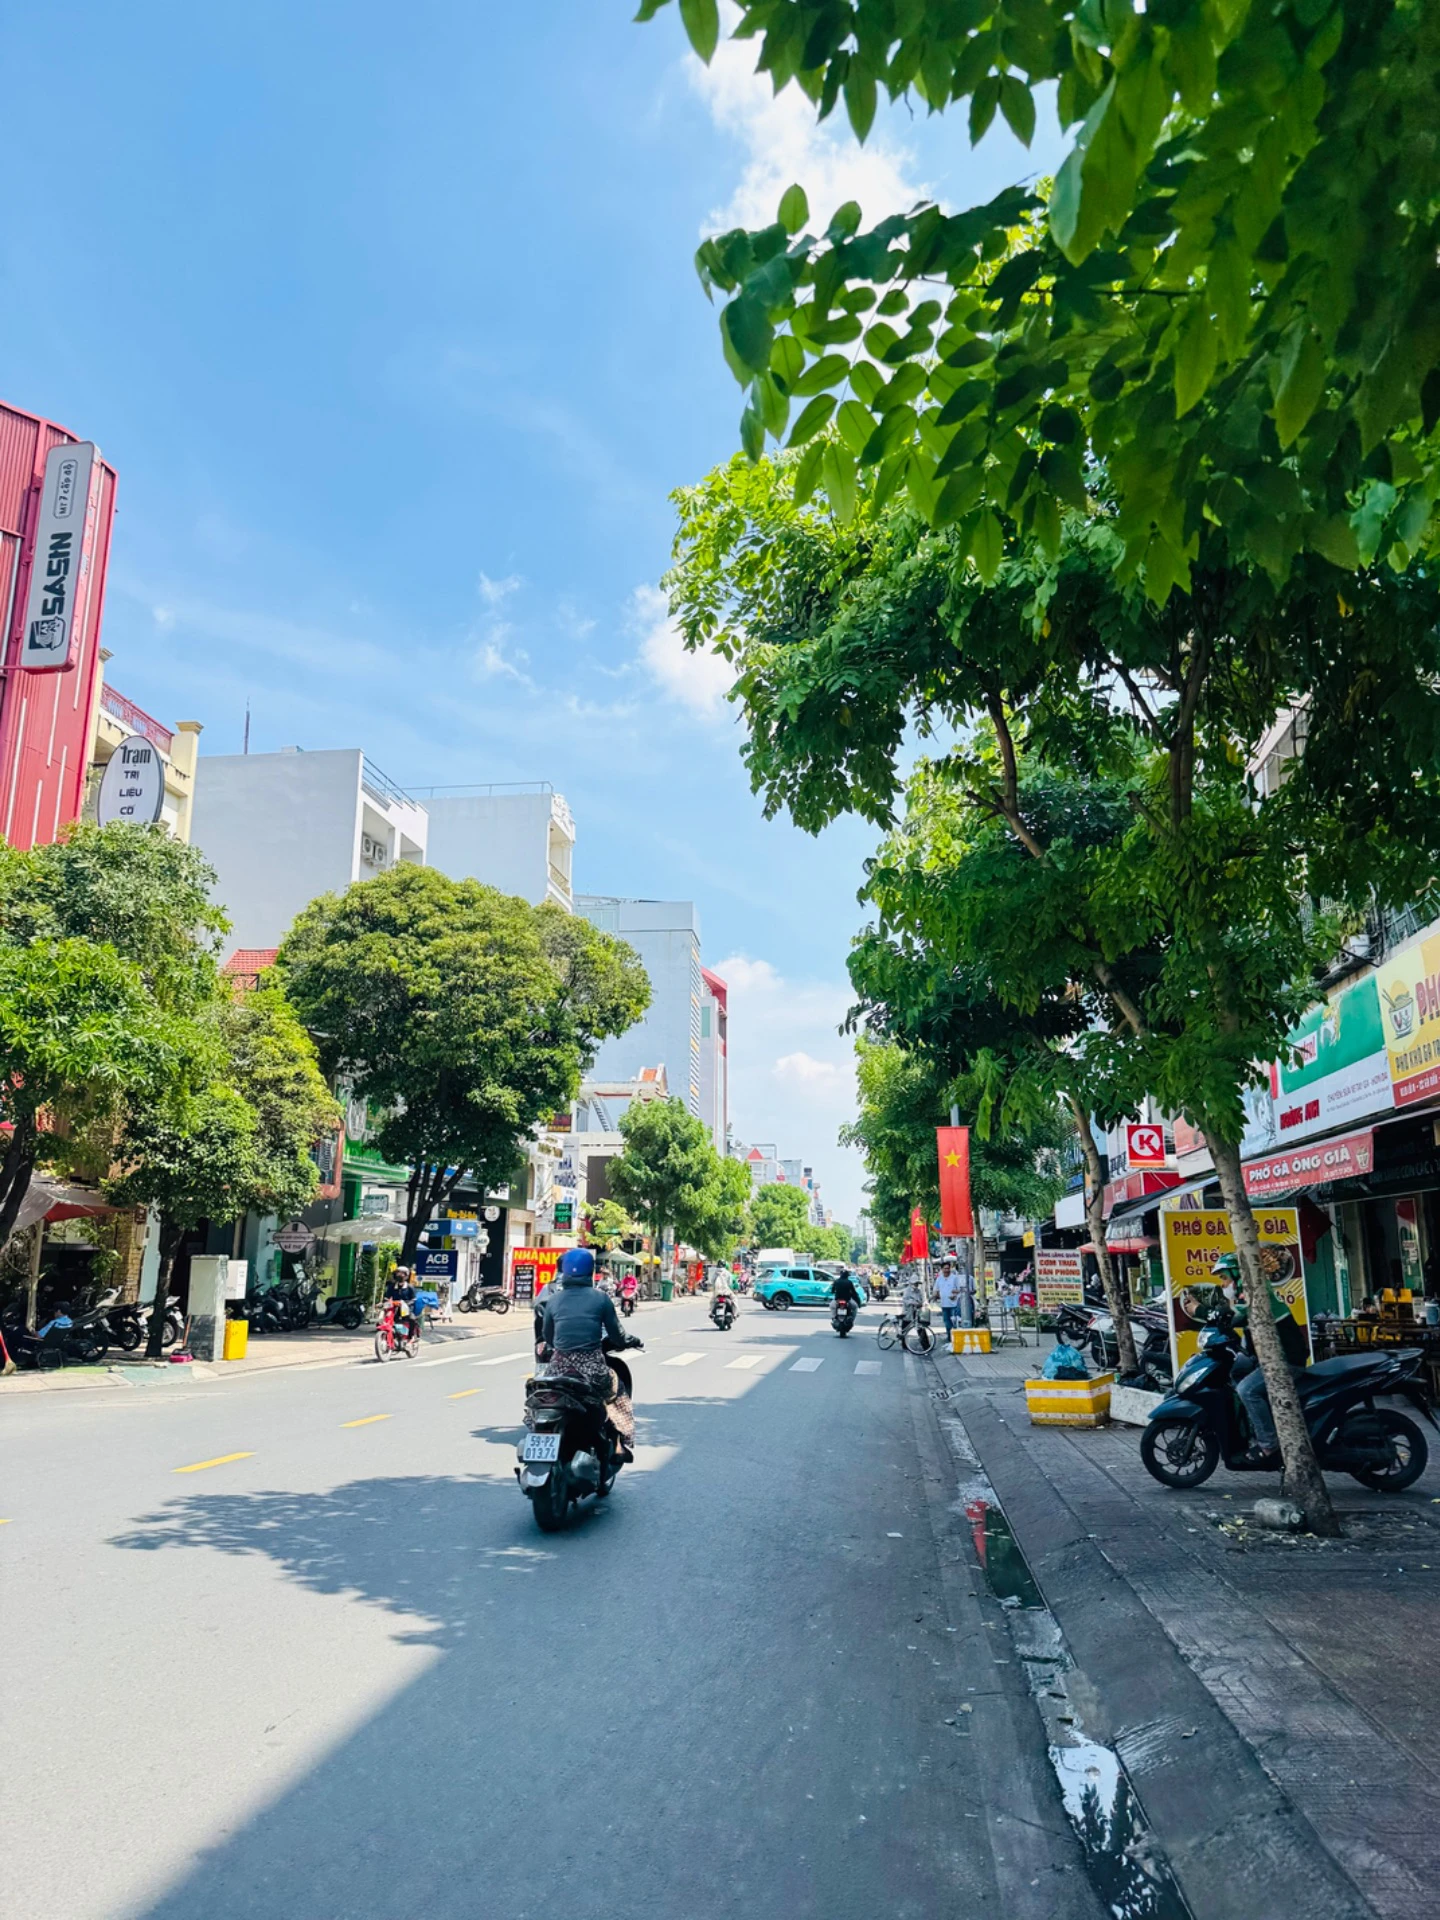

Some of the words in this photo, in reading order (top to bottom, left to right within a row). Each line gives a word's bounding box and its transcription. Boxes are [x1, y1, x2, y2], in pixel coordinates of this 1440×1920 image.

[40, 531, 73, 617] SASIN
[120, 745, 152, 767] Trạm
[124, 770, 140, 780] TRỊ
[119, 787, 143, 799] LIỆU
[1138, 1134, 1160, 1153] K
[1249, 1164, 1270, 1182] PHỞ
[1272, 1159, 1290, 1178] GÀ
[1291, 1151, 1321, 1173] ÔNG
[1173, 1217, 1203, 1236] PHỞ
[1205, 1217, 1227, 1235] GÀ
[425, 1253, 450, 1265] ACB
[514, 1247, 538, 1261] NHÀ
[1187, 1246, 1224, 1263] Miế
[1185, 1265, 1203, 1276] Gà
[530, 1435, 555, 1448] 59-P2
